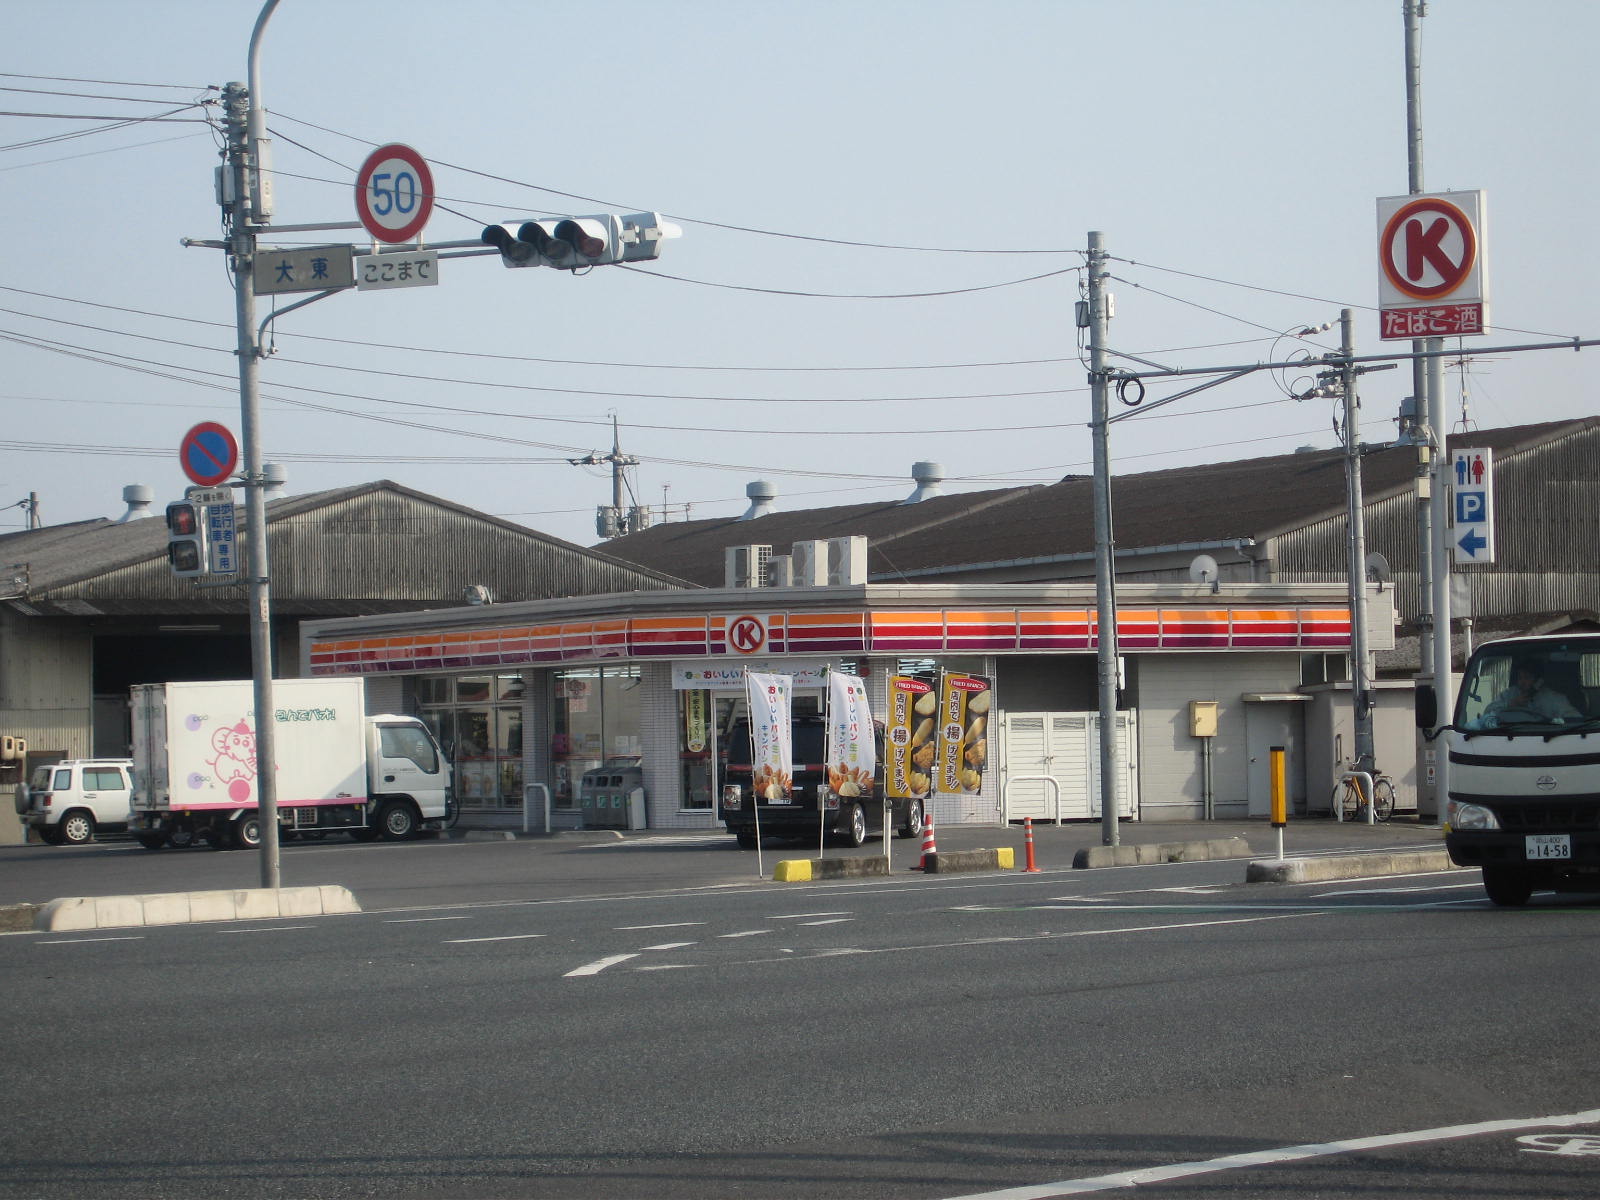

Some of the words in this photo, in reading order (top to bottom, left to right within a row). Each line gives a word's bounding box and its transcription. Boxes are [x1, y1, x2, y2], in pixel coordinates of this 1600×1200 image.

[372, 171, 415, 216] 50
[276, 257, 330, 283] 大東
[363, 260, 432, 283] ここまで
[1462, 496, 1482, 520] P
